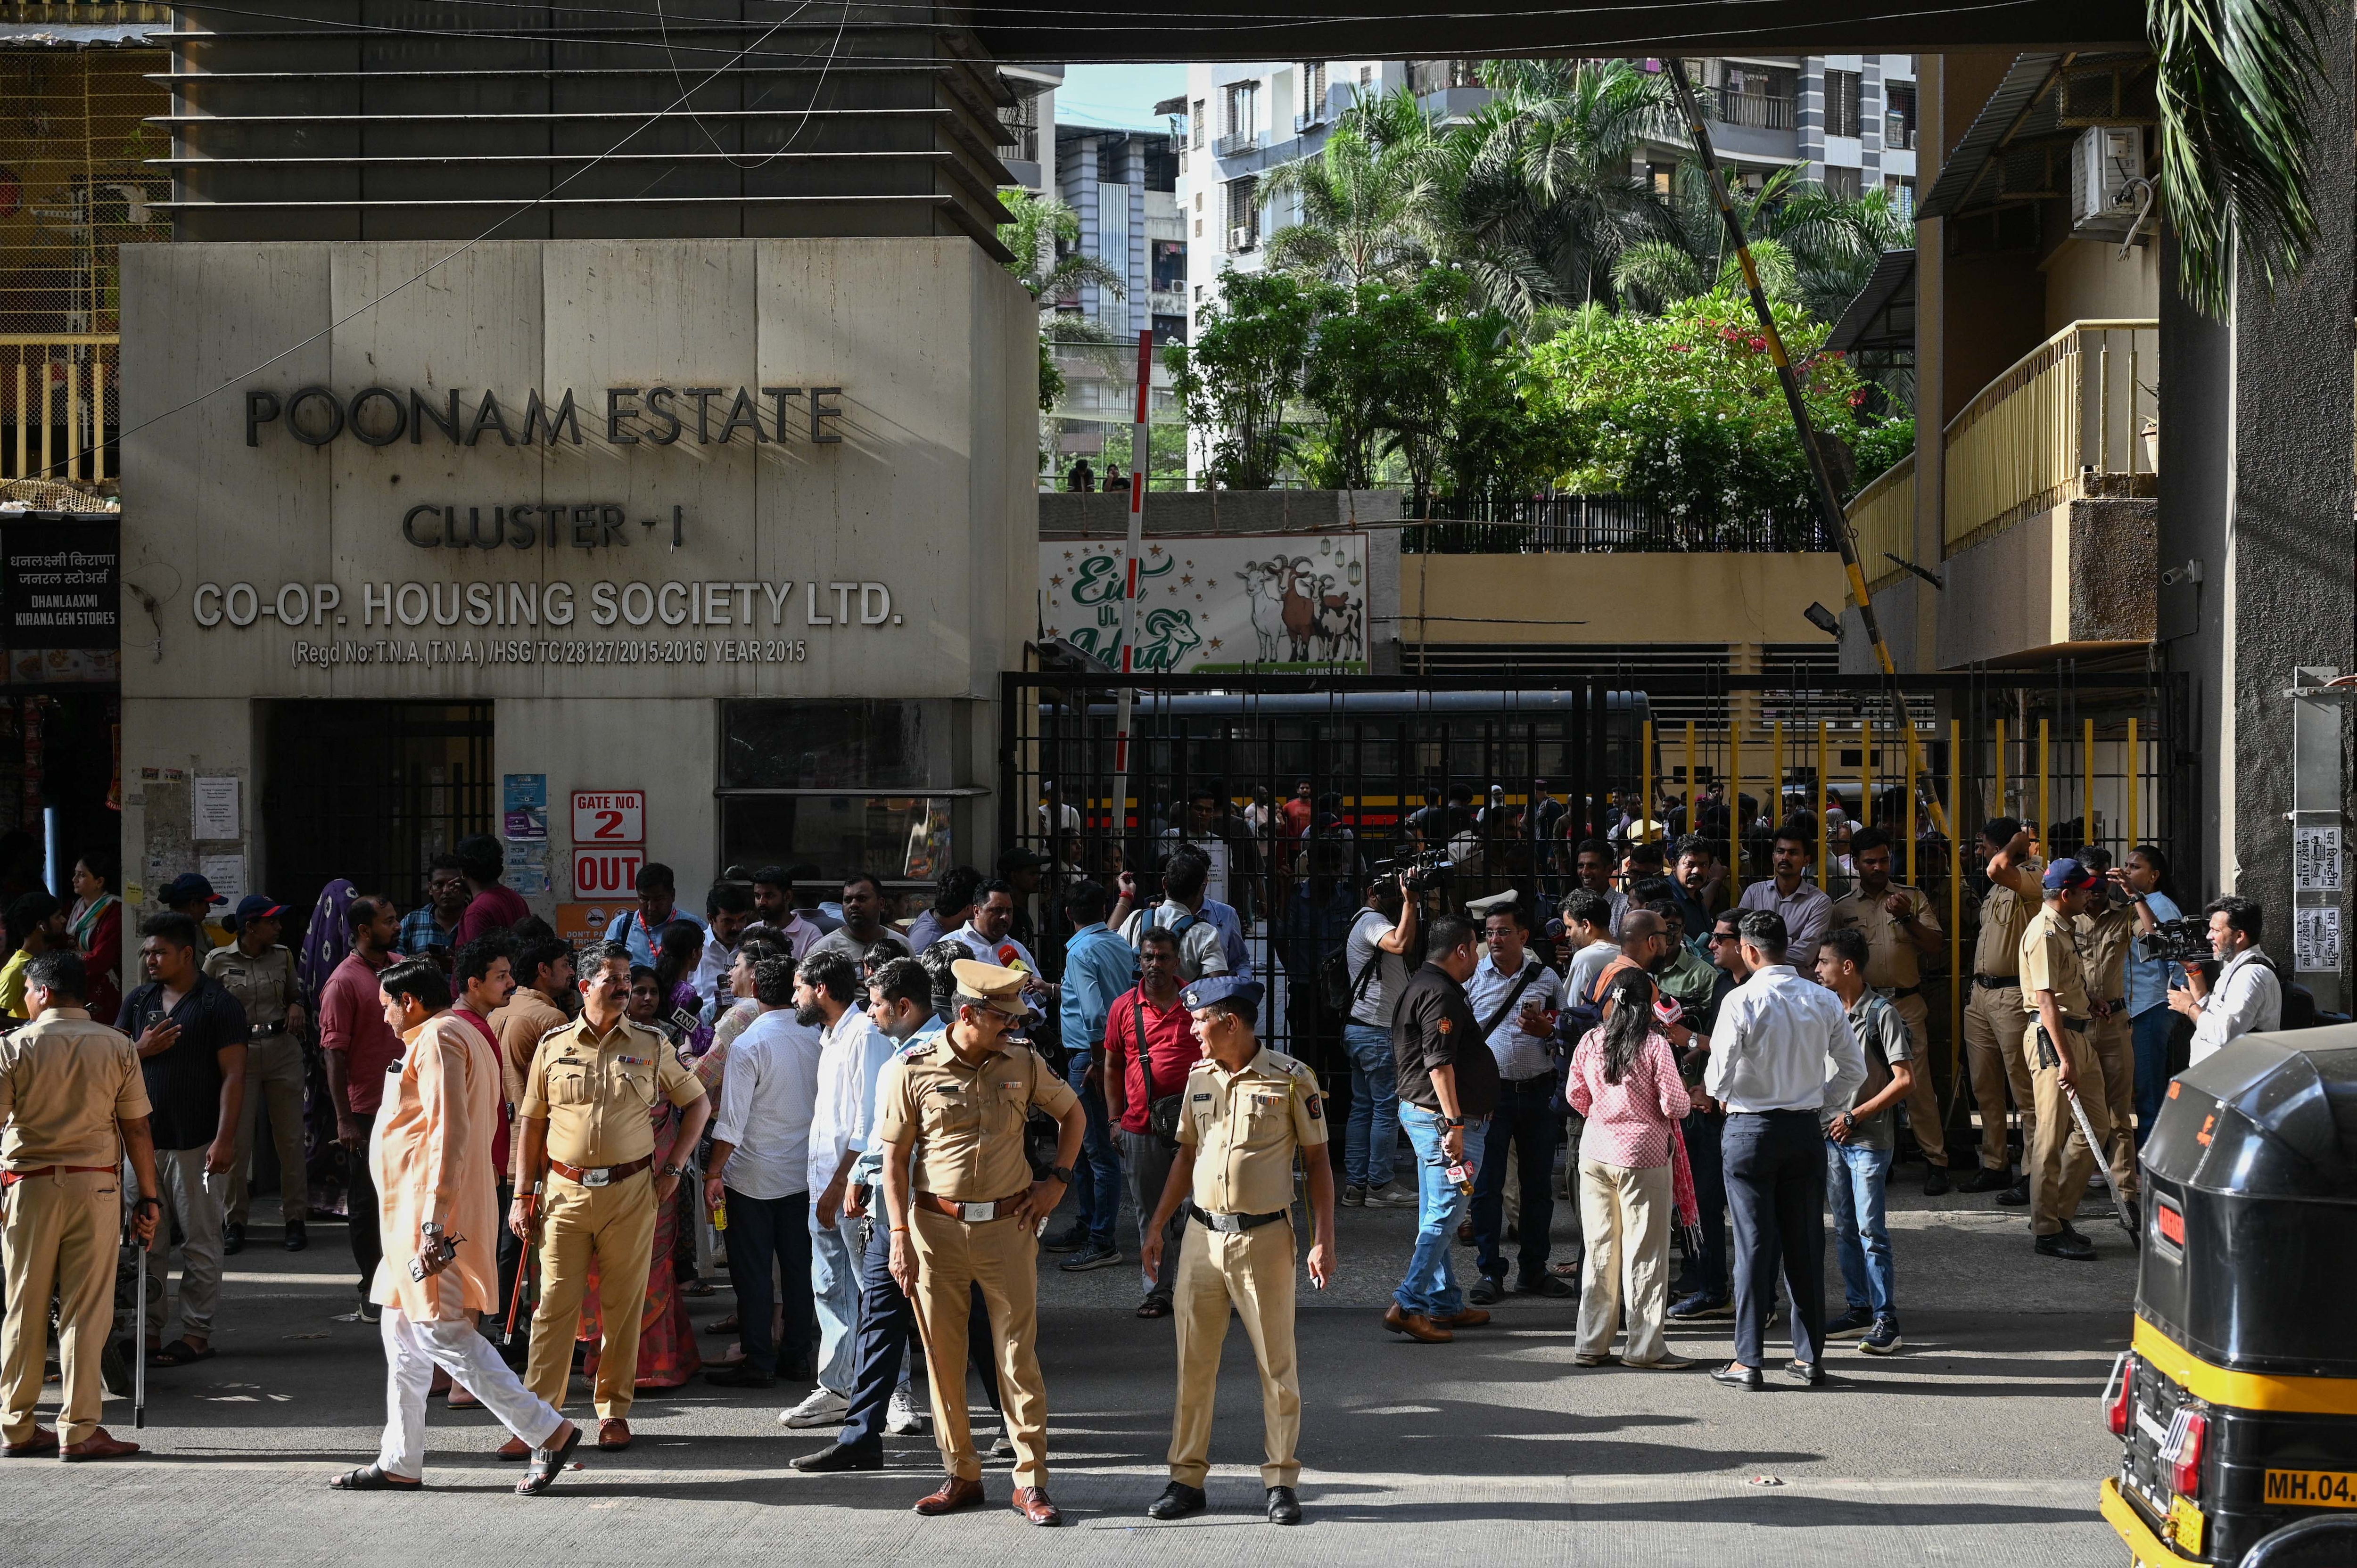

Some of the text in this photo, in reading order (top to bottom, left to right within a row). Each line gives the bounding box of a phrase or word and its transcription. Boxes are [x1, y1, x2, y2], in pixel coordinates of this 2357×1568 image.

[247, 386, 842, 447] POONAM ESTATE
[403, 505, 629, 550] CLUSTER
[10, 551, 115, 567] धनलक्ष्मी किराणा
[19, 569, 109, 585] जनरल स्टोअर्स
[32, 594, 98, 608] DHANLAAXMI
[193, 582, 902, 626] CO-OP. HOUSING SOCIETY LTD.
[16, 612, 115, 626] KIRANA GEN STORES
[292, 640, 339, 668] (Regd
[713, 640, 761, 662] YEAR
[766, 640, 806, 662] 2015
[578, 796, 639, 809] GATE NO.
[594, 811, 624, 838] 2
[2326, 831, 2334, 845] घर
[578, 857, 640, 890] OUT
[2327, 912, 2335, 925] घर
[675, 1013, 695, 1029] ANI
[2268, 1473, 2357, 1502] MH.04.
